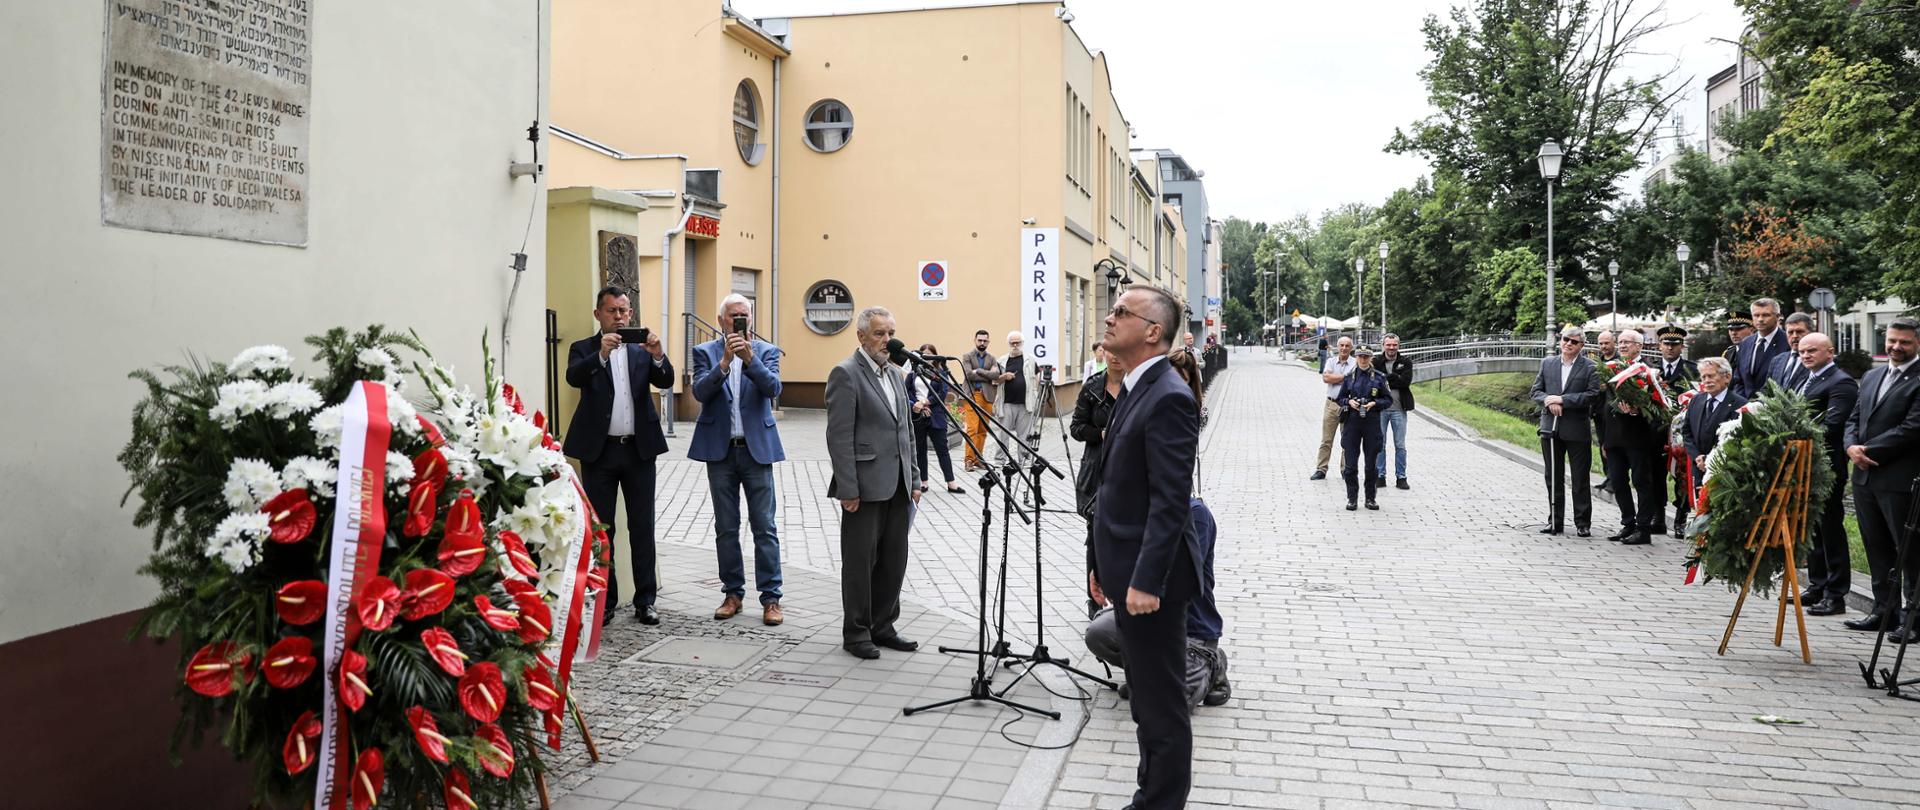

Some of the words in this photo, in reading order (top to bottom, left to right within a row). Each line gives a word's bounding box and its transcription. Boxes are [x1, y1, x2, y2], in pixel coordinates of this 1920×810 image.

[113, 77, 139, 94] RED
[144, 84, 162, 100] ON
[168, 88, 196, 106] JULY
[201, 98, 224, 114] THE
[242, 107, 253, 121] IN
[257, 109, 281, 127] 1946
[114, 60, 126, 75] IN
[130, 63, 179, 86] MEMORY
[182, 78, 195, 91] OF
[201, 81, 221, 96] THE
[224, 89, 238, 103] 42
[240, 92, 269, 109] JEWS
[272, 99, 306, 118] MURDE-
[113, 94, 158, 116] DURING
[246, 121, 275, 141] RIOTS
[113, 111, 218, 142] COMMEMORATING
[222, 133, 252, 151] PLATE
[258, 141, 268, 153] IS
[271, 142, 298, 159] BUILT
[112, 145, 127, 161] BY
[131, 149, 210, 174] NISSENBAUM
[217, 163, 283, 186] FOUNDATION
[149, 136, 228, 161] ANNIVERSARY
[232, 150, 244, 163] OF
[249, 153, 269, 169] THIS
[271, 157, 304, 175] EVENTS
[112, 163, 129, 178] ON
[133, 166, 154, 182] THE
[221, 179, 233, 191] OF
[238, 182, 259, 196] LECH
[263, 185, 301, 203] WALESA
[112, 178, 134, 195] THE
[141, 184, 188, 202] LEADER
[193, 190, 207, 205] OF
[213, 193, 280, 216] SOLIDARITY.
[1034, 233, 1046, 358] PARKING
[347, 465, 374, 532] POLSKIEJ
